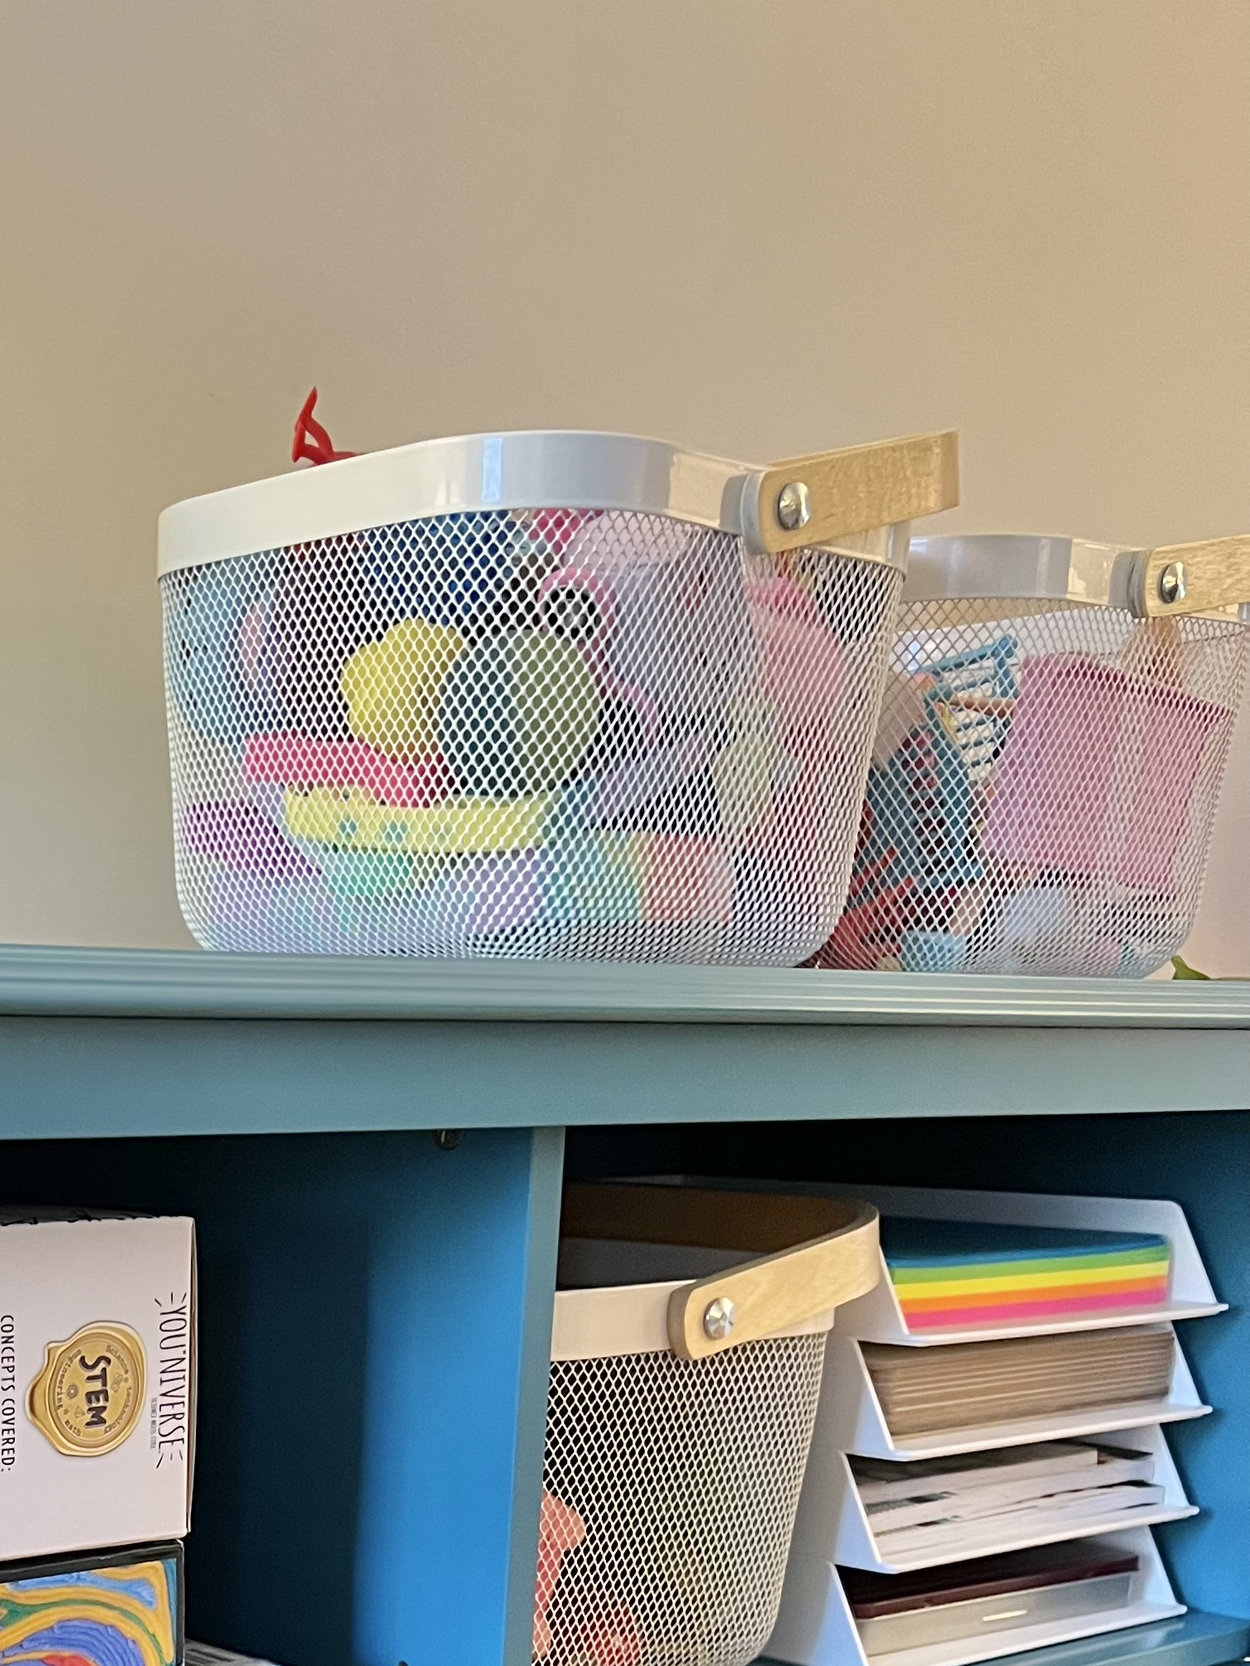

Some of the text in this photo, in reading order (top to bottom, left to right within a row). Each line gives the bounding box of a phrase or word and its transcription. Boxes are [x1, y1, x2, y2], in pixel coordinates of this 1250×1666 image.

[55, 1348, 83, 1411] engineering
[79, 1355, 112, 1428] STEM
[105, 1344, 130, 1376] Science
[0, 1314, 16, 1473] CONCEPTS COVERED:
[64, 1419, 82, 1438] math
